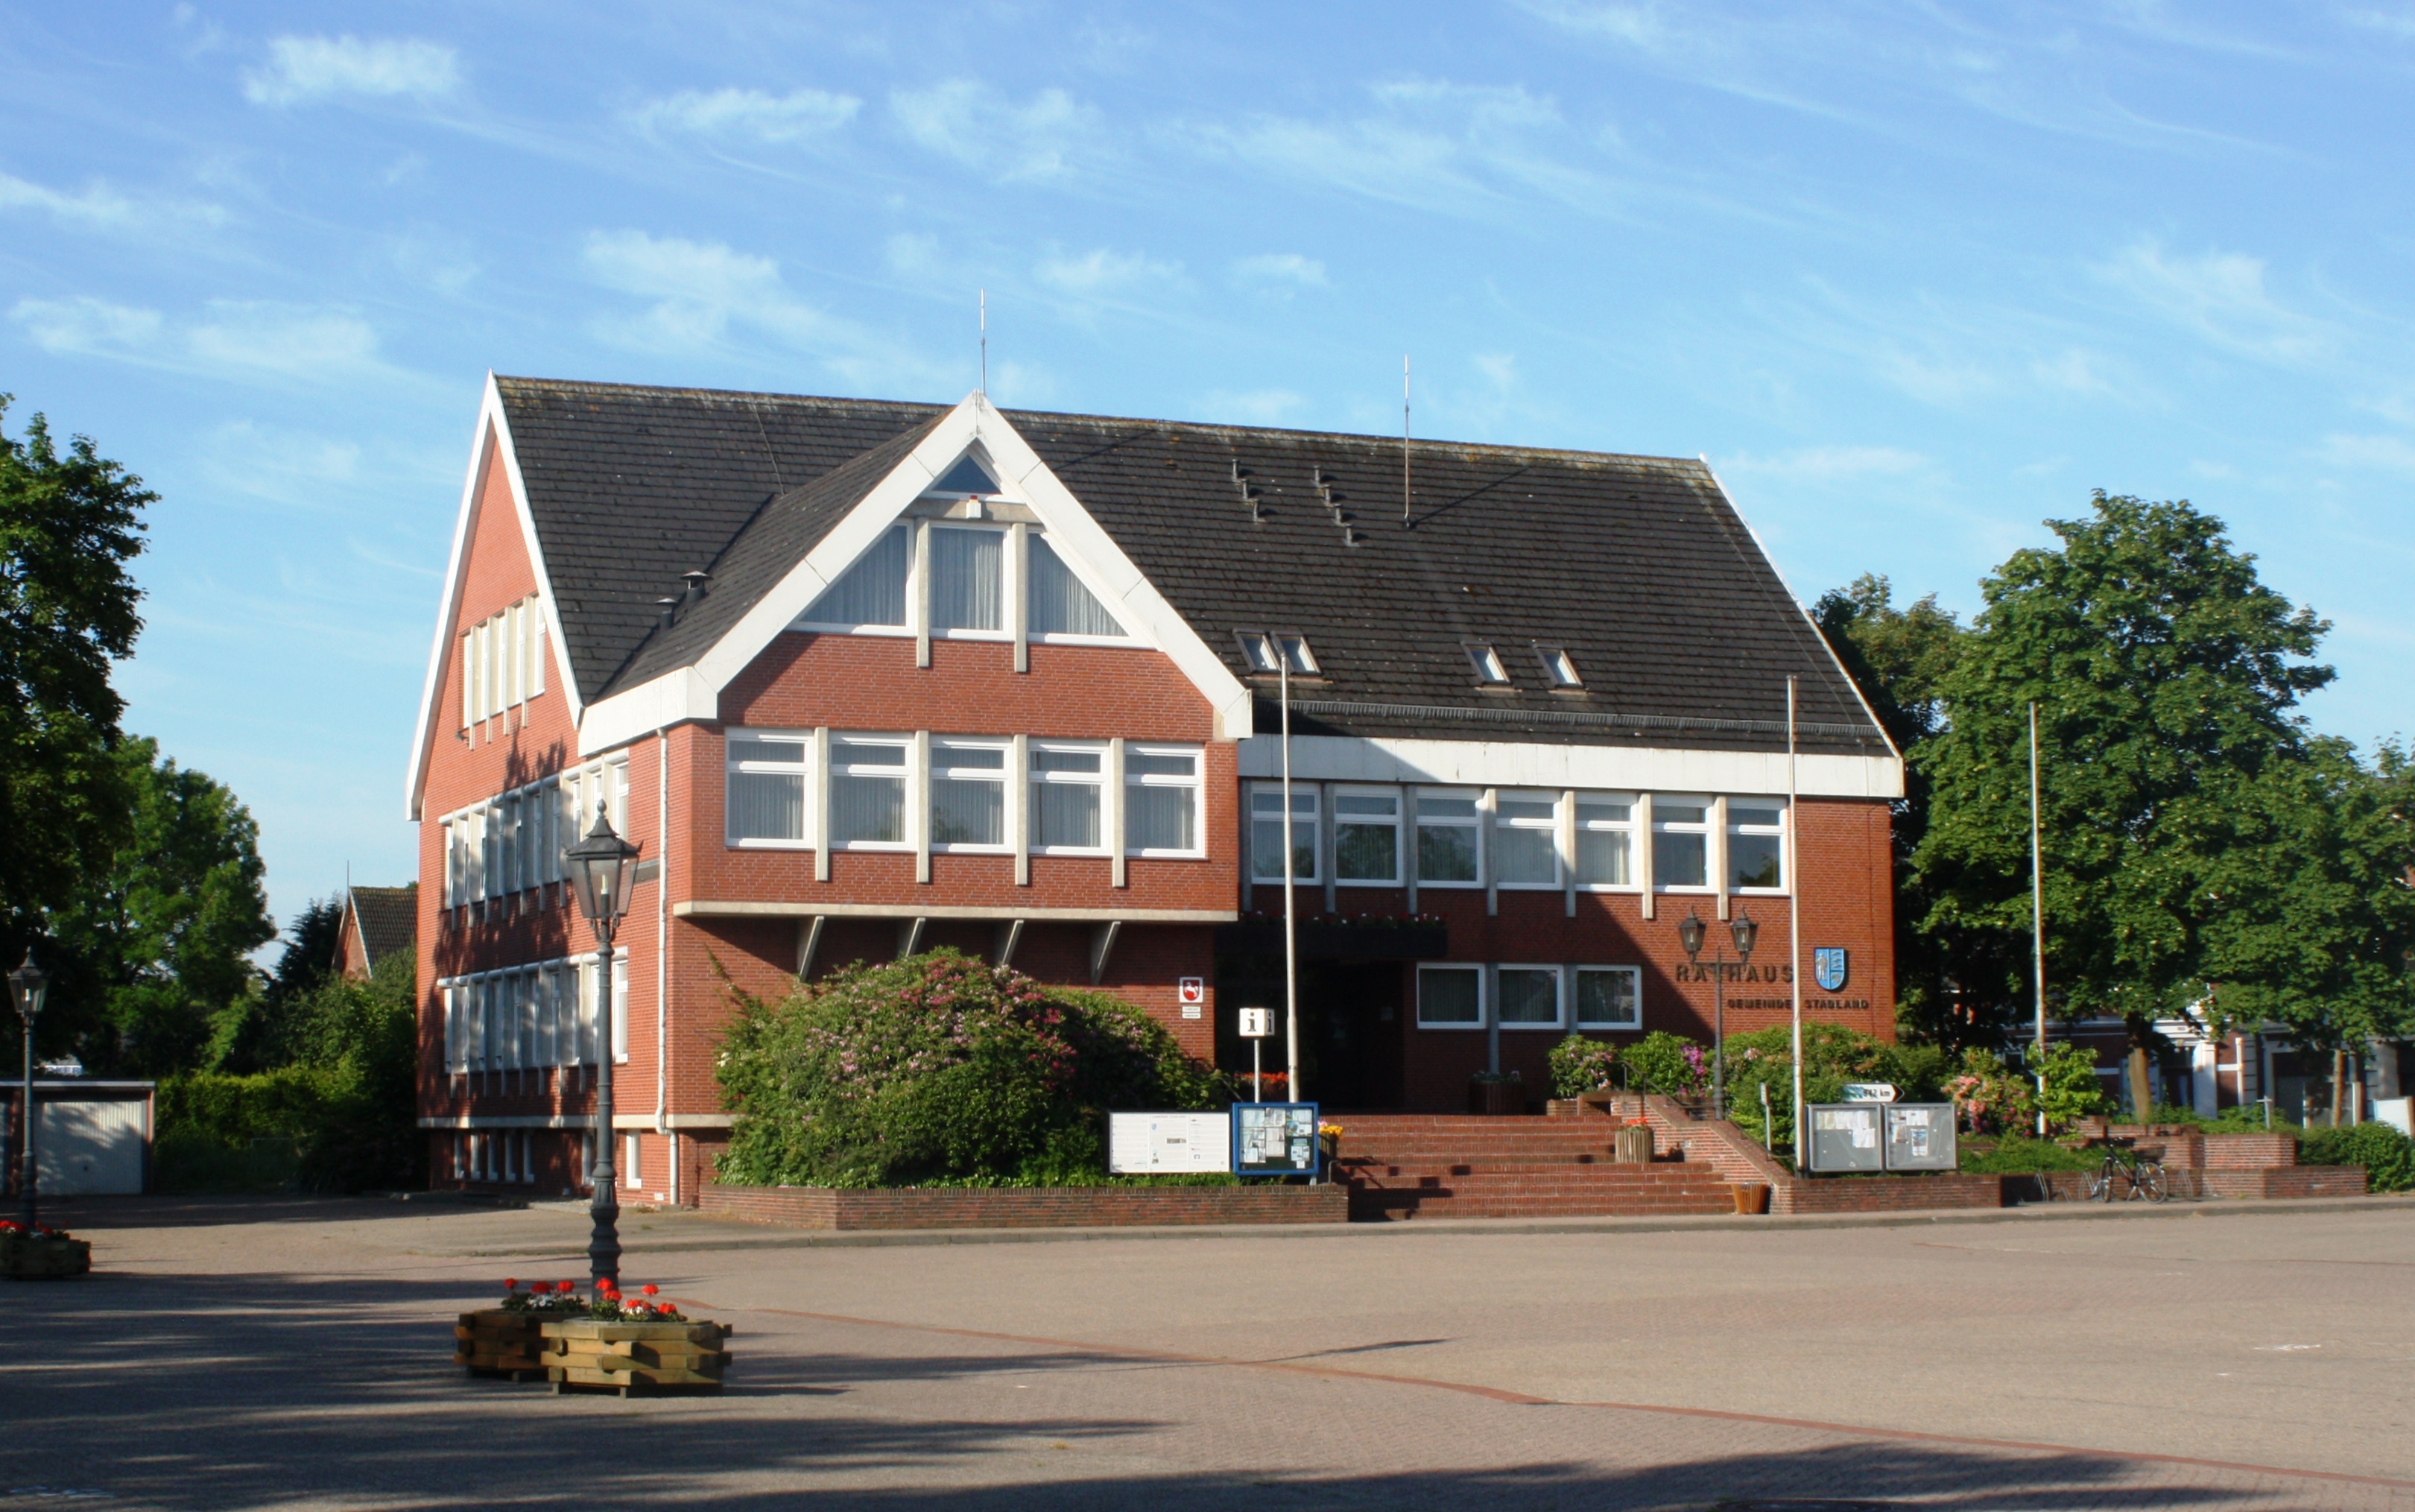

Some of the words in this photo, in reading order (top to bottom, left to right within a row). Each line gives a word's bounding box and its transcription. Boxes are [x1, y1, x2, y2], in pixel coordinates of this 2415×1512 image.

[1727, 999, 1793, 1009] GEMEINDE
[1805, 999, 1870, 1010] STADLAND
[1248, 1012, 1256, 1032] i
